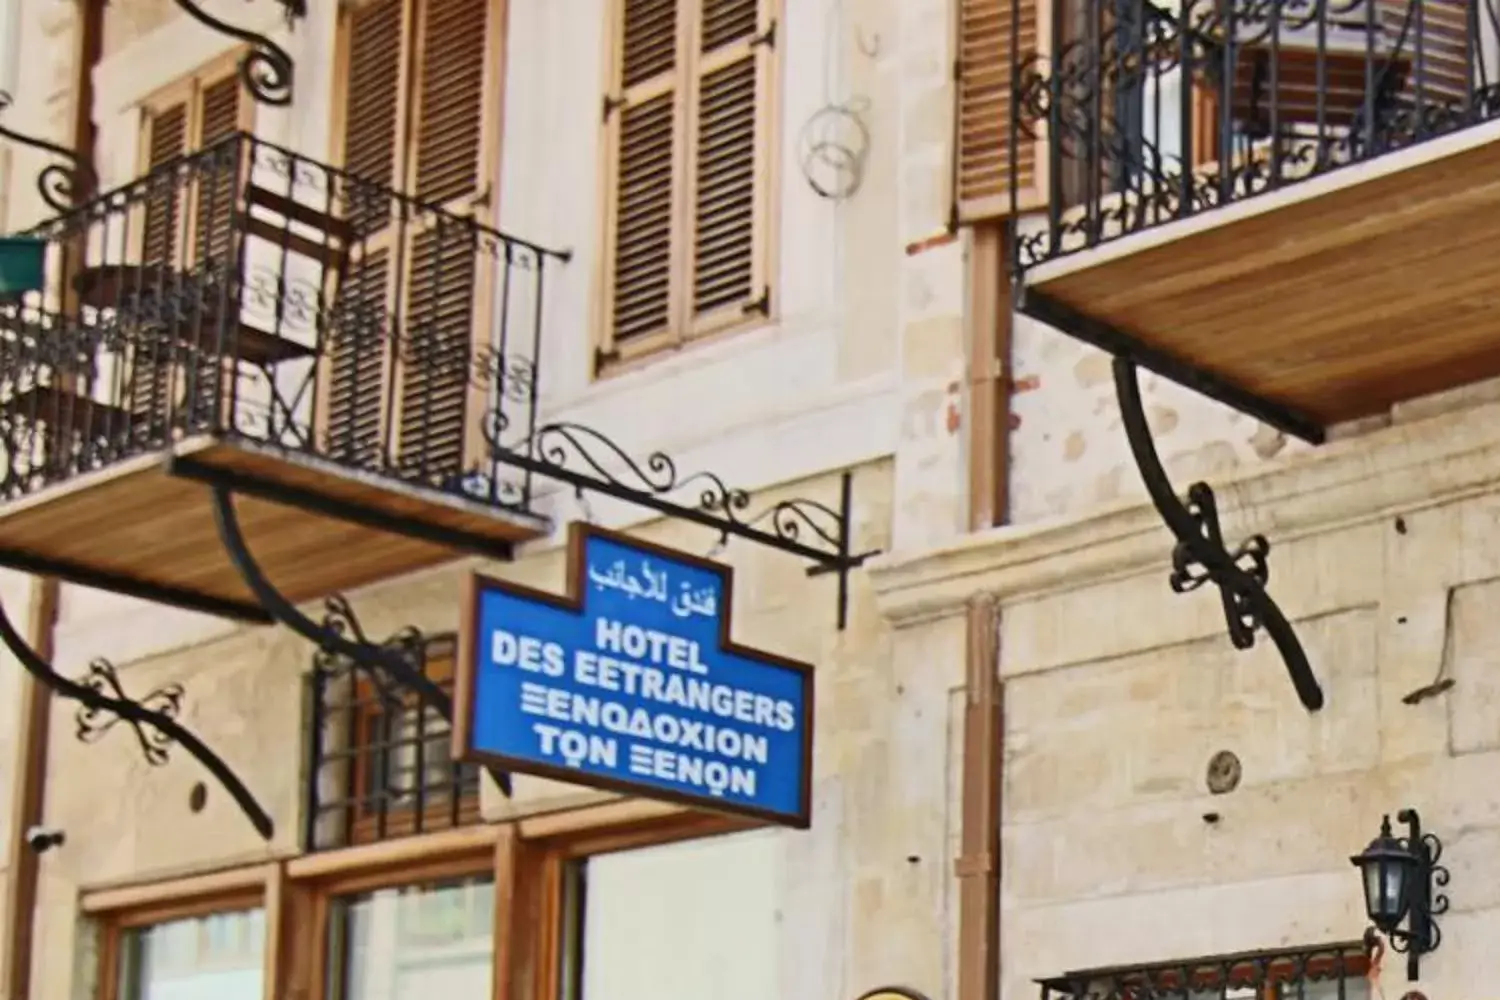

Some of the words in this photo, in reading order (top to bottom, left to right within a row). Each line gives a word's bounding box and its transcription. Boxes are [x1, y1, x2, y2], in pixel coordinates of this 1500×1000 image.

[491, 629, 566, 678] DES
[573, 650, 796, 732] EETRANGERS
[595, 617, 709, 675] HOTEL
